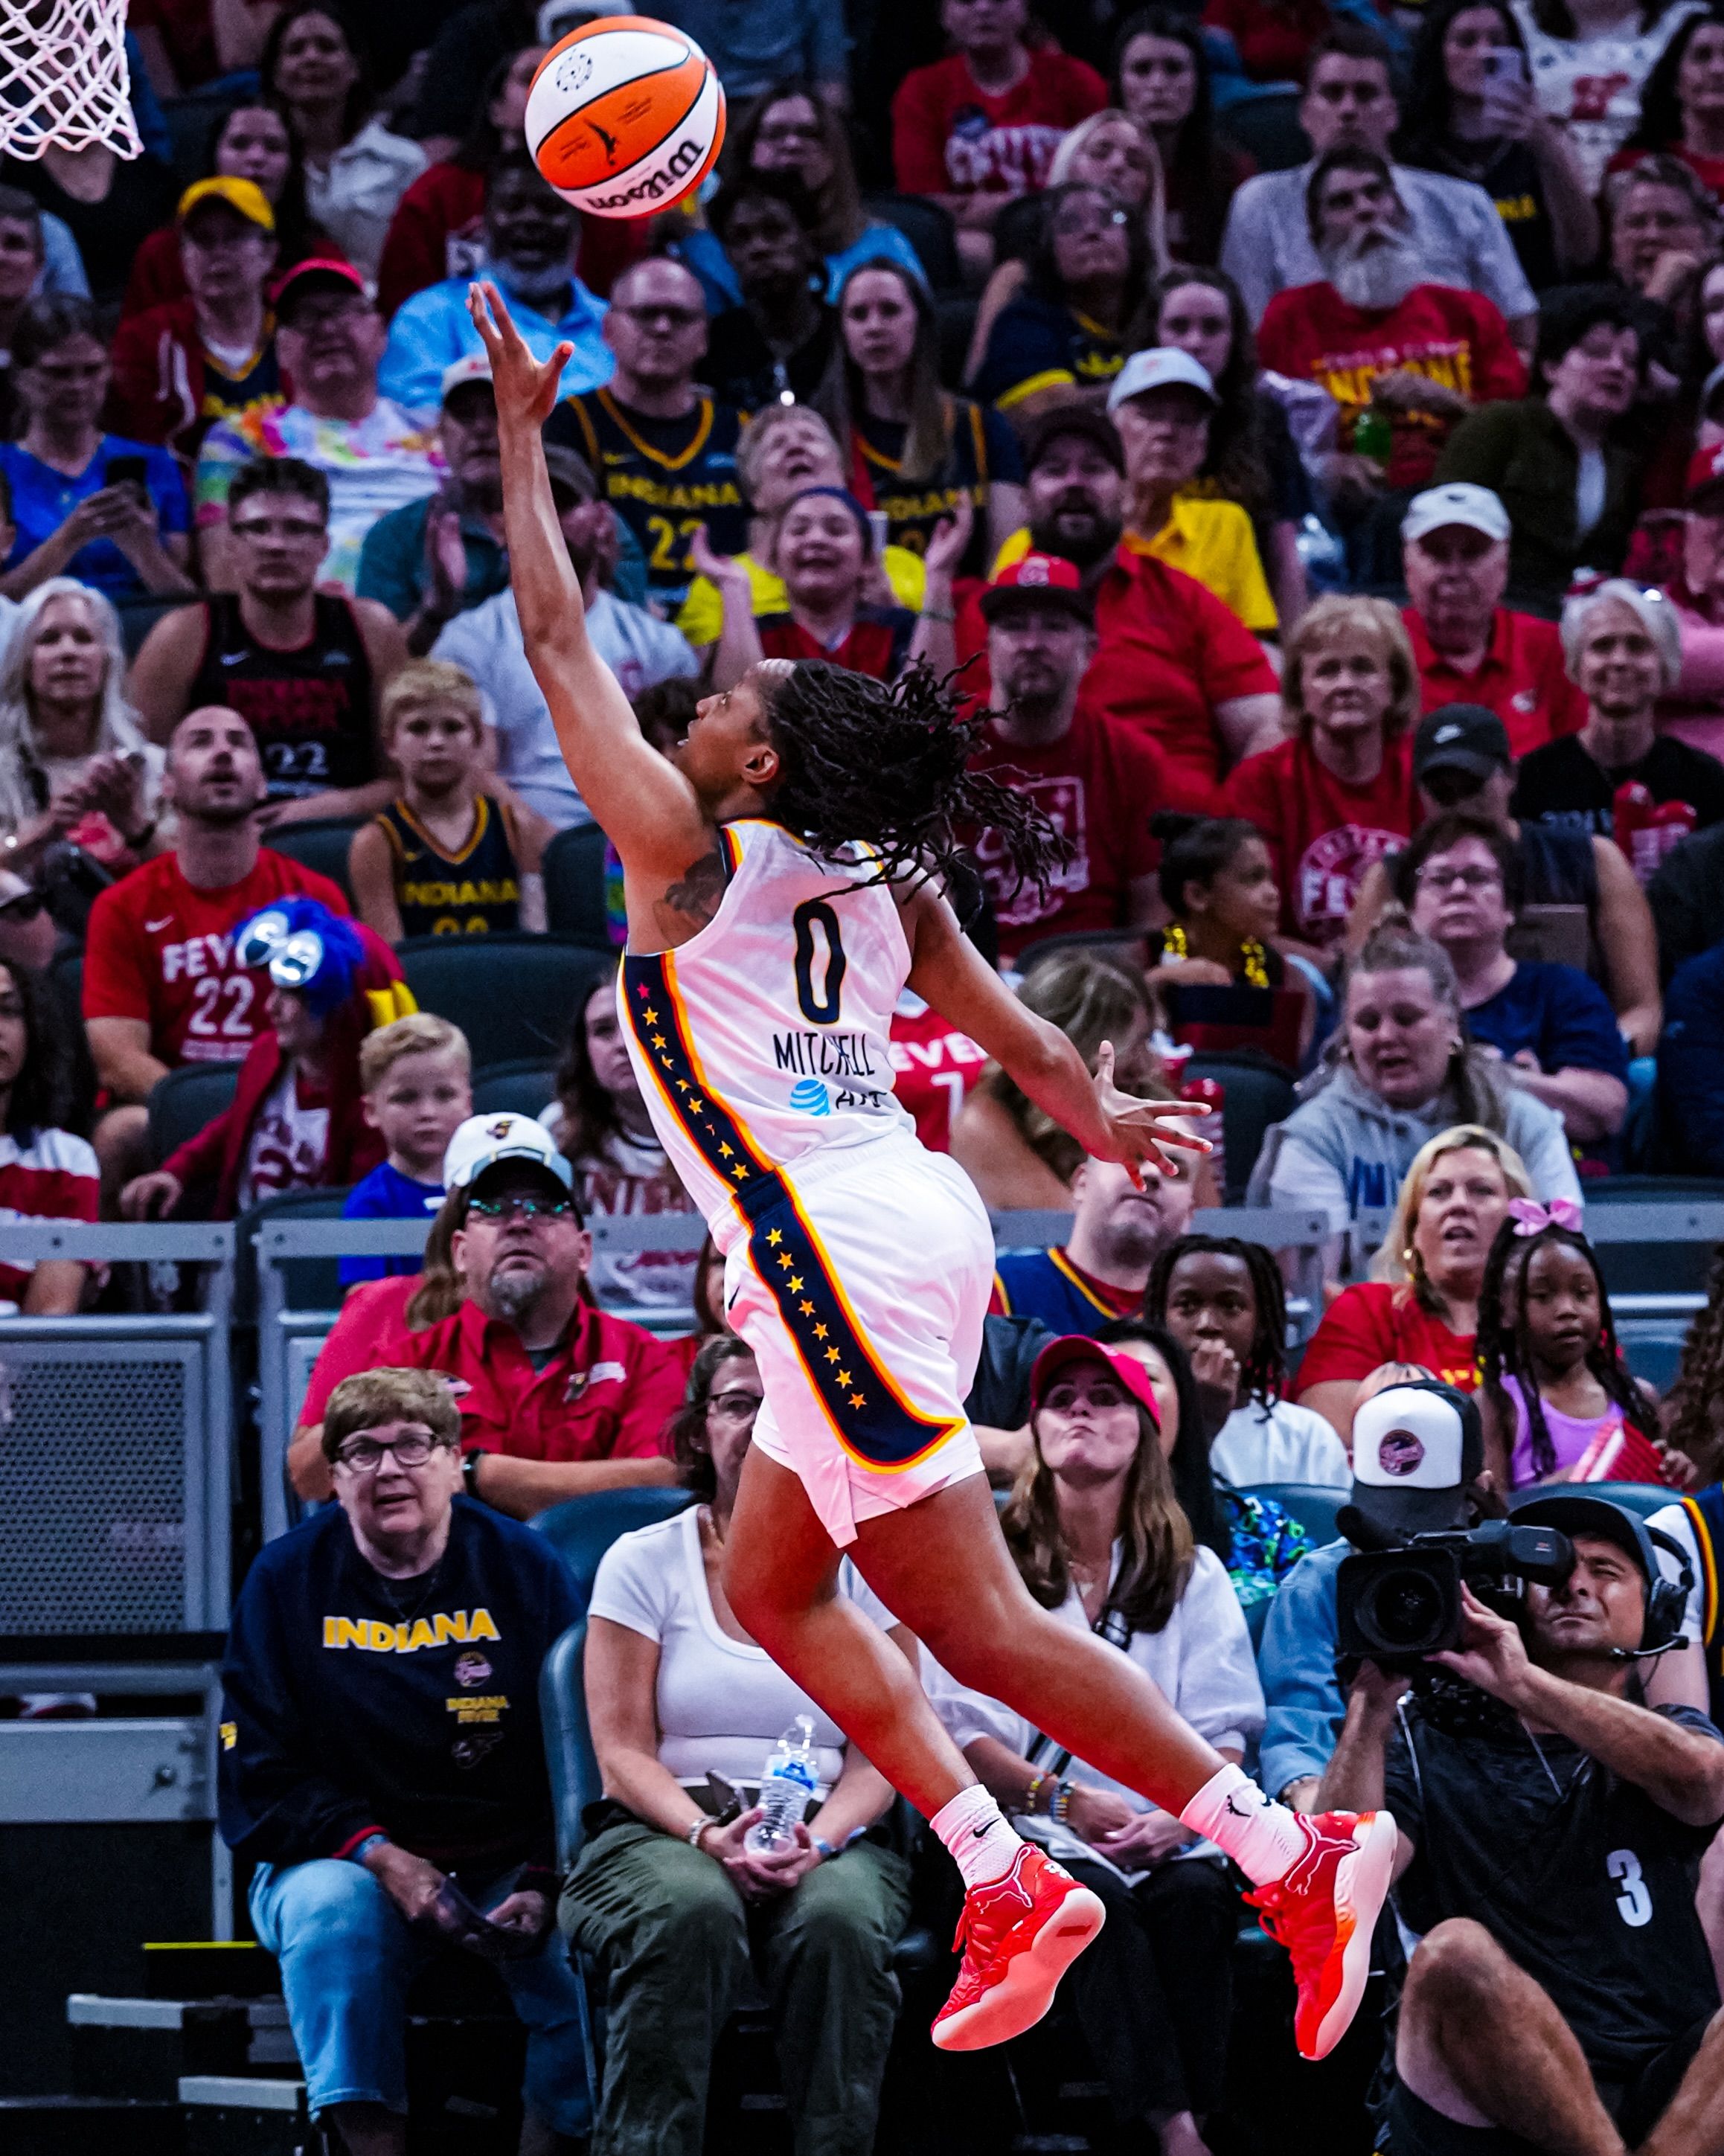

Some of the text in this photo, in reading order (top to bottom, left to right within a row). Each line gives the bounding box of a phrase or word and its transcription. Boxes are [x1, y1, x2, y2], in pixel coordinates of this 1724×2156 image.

[585, 139, 705, 209] Wilson
[403, 877, 520, 906] NDIANA
[162, 933, 235, 983] FEV
[793, 900, 847, 1024] 0
[188, 975, 255, 1036] 22
[886, 1031, 990, 1072] EVE
[322, 1608, 502, 1655] INDIANA
[1606, 1849, 1653, 1927] 3
